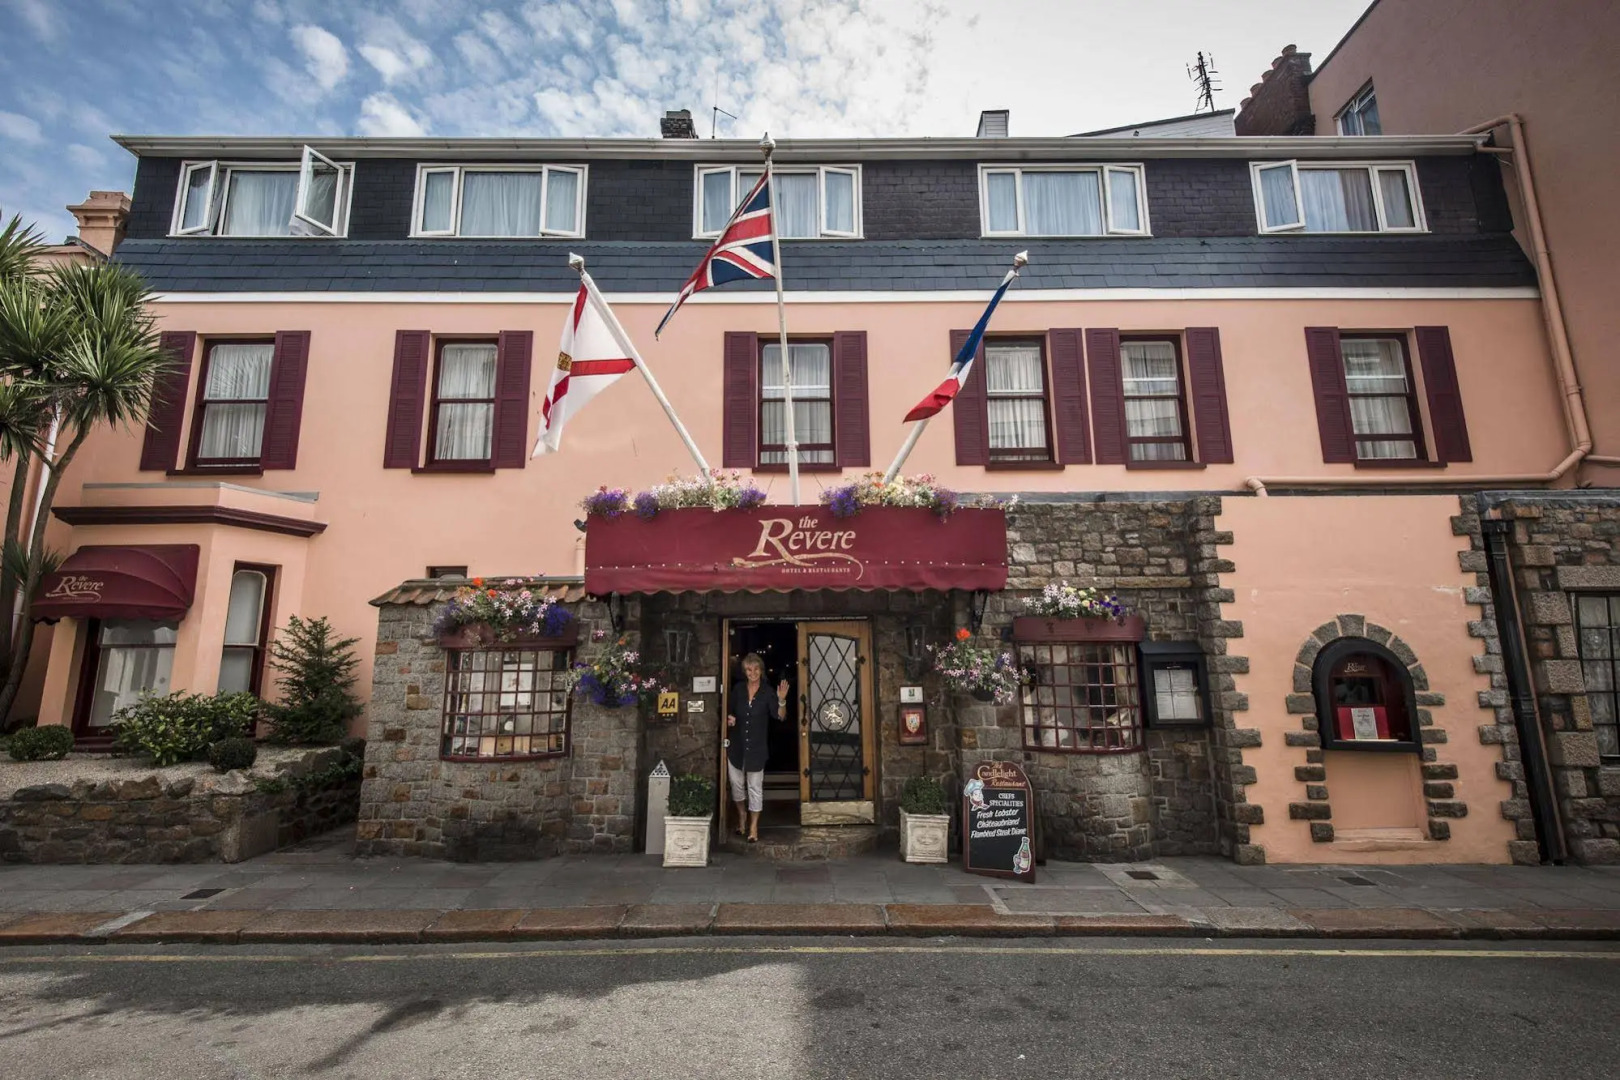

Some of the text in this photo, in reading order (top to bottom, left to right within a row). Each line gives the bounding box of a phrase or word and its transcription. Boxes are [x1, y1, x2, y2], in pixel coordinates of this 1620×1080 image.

[798, 516, 818, 528] the
[747, 518, 856, 566] Revere
[52, 576, 104, 597] Revere
[661, 698, 676, 709] AA
[977, 765, 1017, 780] Candlelight
[976, 808, 1019, 819] Fresh Lobster
[996, 828, 1011, 837] Steak
[1011, 827, 1027, 836] Diane
